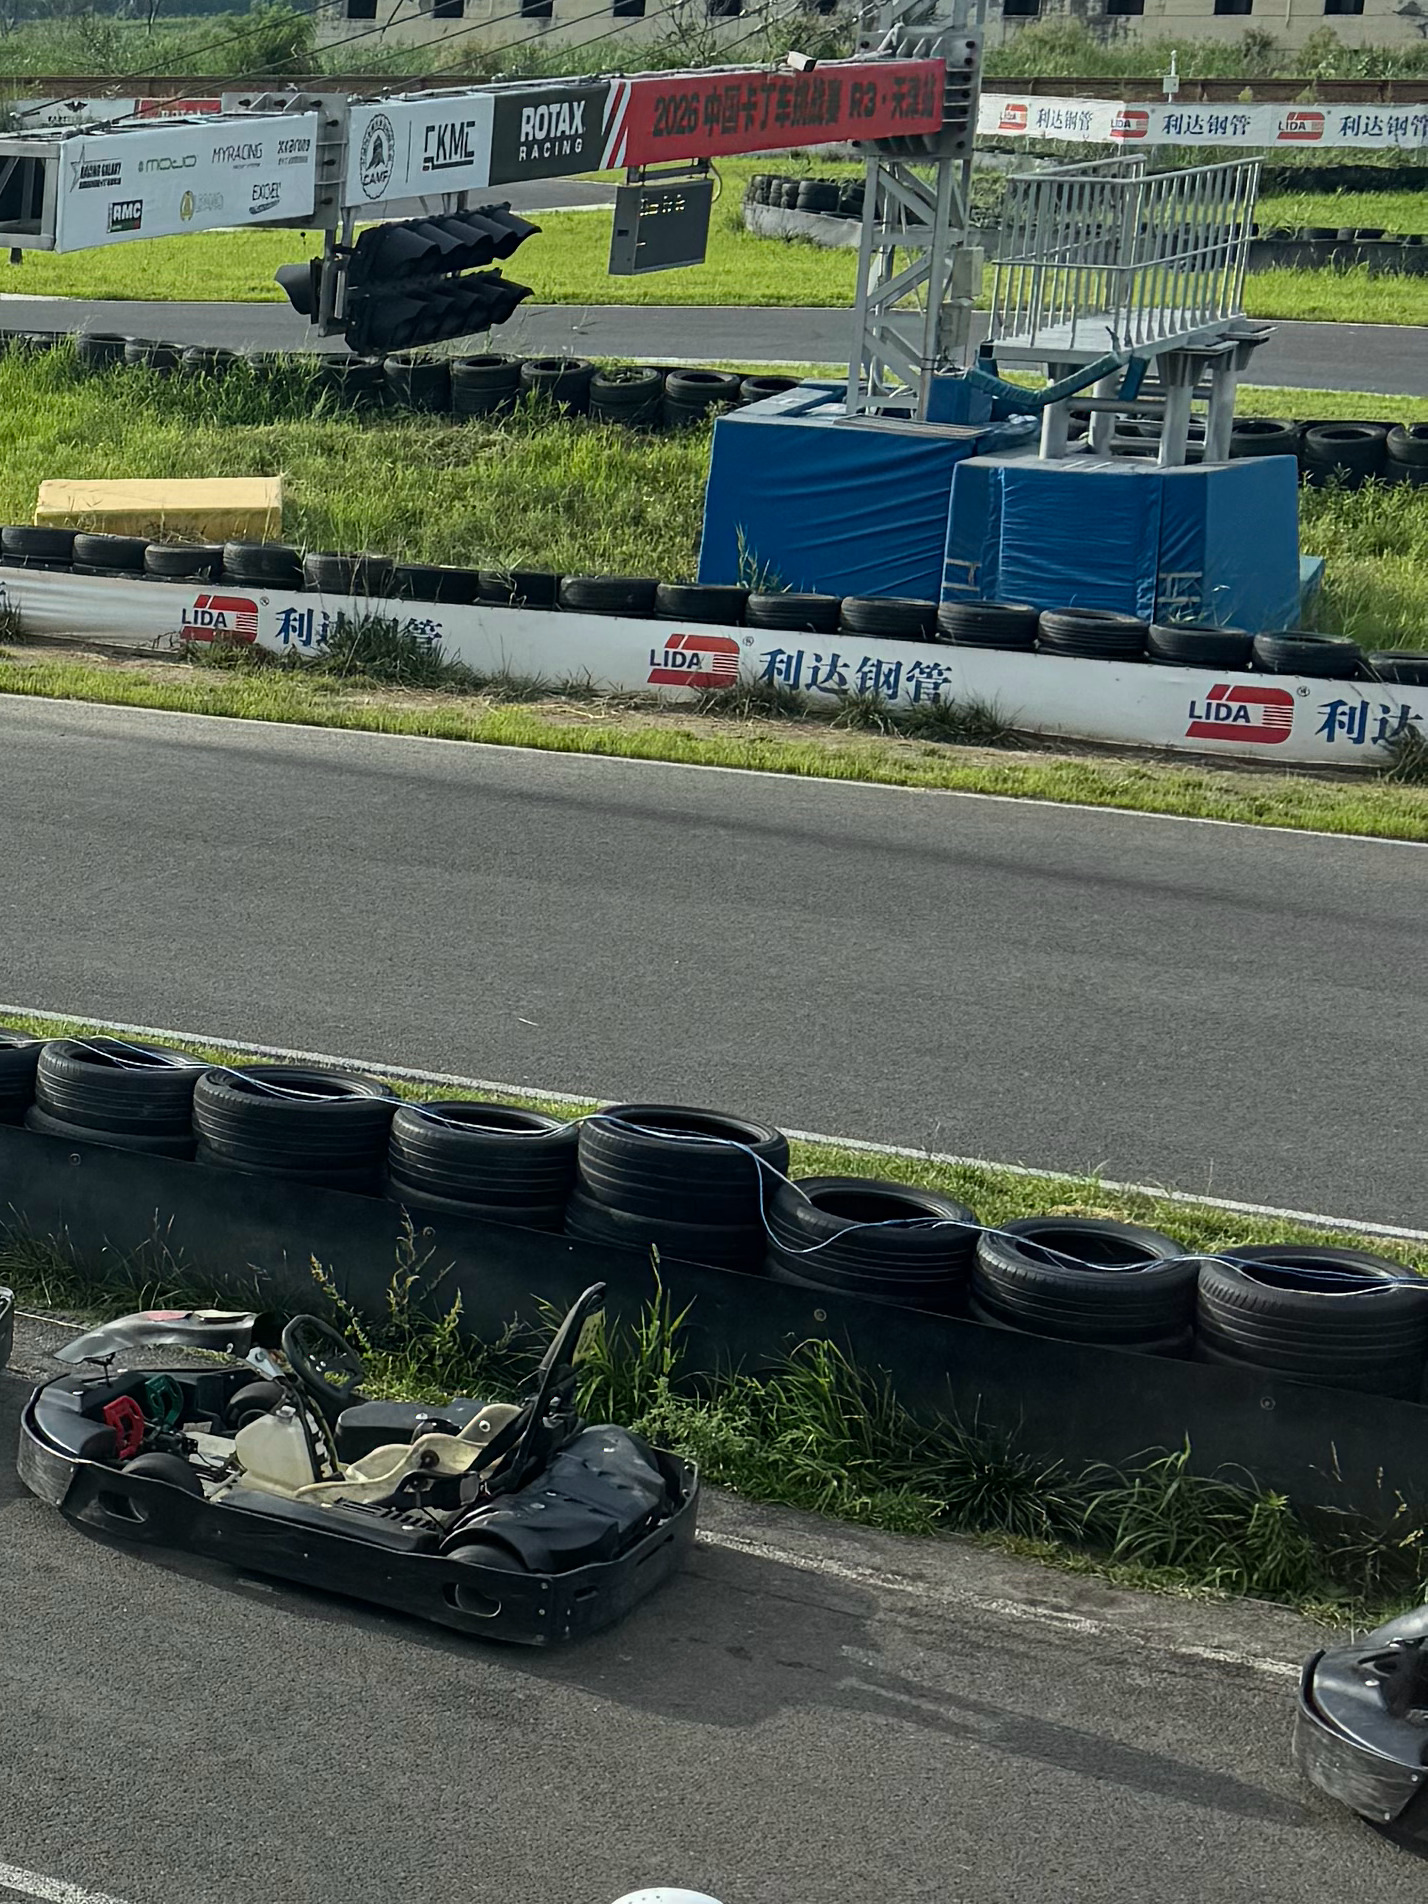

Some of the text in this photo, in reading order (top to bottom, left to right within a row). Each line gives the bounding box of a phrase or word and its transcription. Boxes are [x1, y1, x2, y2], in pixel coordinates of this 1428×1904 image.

[520, 100, 586, 143] ROTAX
[1161, 113, 1251, 136] 利达钢管
[1277, 120, 1307, 132] LIDA
[518, 138, 583, 163] RACING
[181, 608, 228, 628] LIDA
[649, 648, 701, 670] LIDA
[758, 647, 953, 704] 利达钢管
[1188, 699, 1251, 724] LIDA
